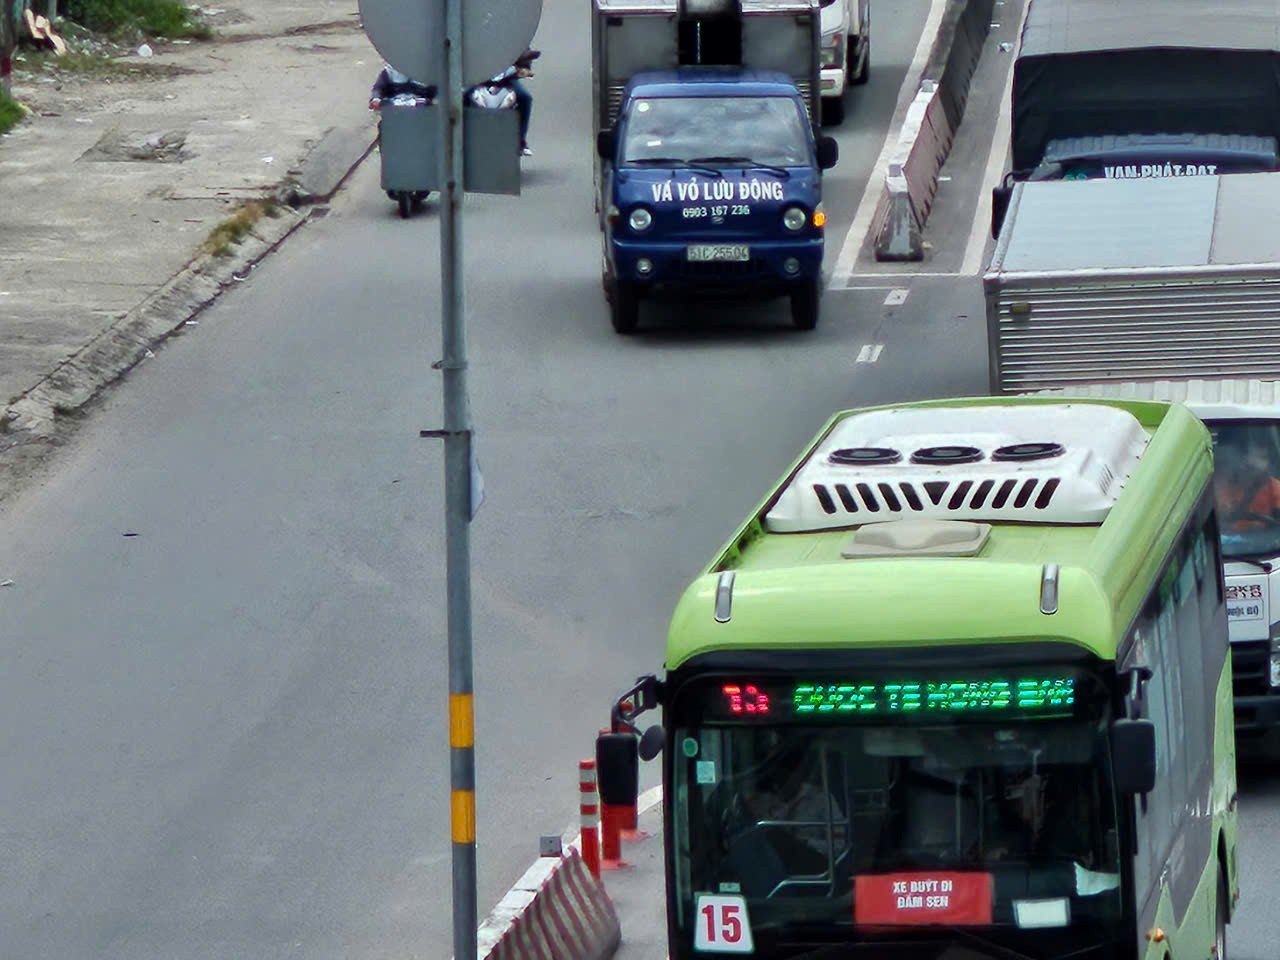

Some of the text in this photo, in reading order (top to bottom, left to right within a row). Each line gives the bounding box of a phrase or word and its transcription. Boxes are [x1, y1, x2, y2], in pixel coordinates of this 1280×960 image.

[652, 180, 673, 202] VÁ
[678, 177, 700, 201] VỎ
[893, 881, 907, 893] XE
[926, 895, 949, 908] SEN
[702, 905, 742, 943] 15
